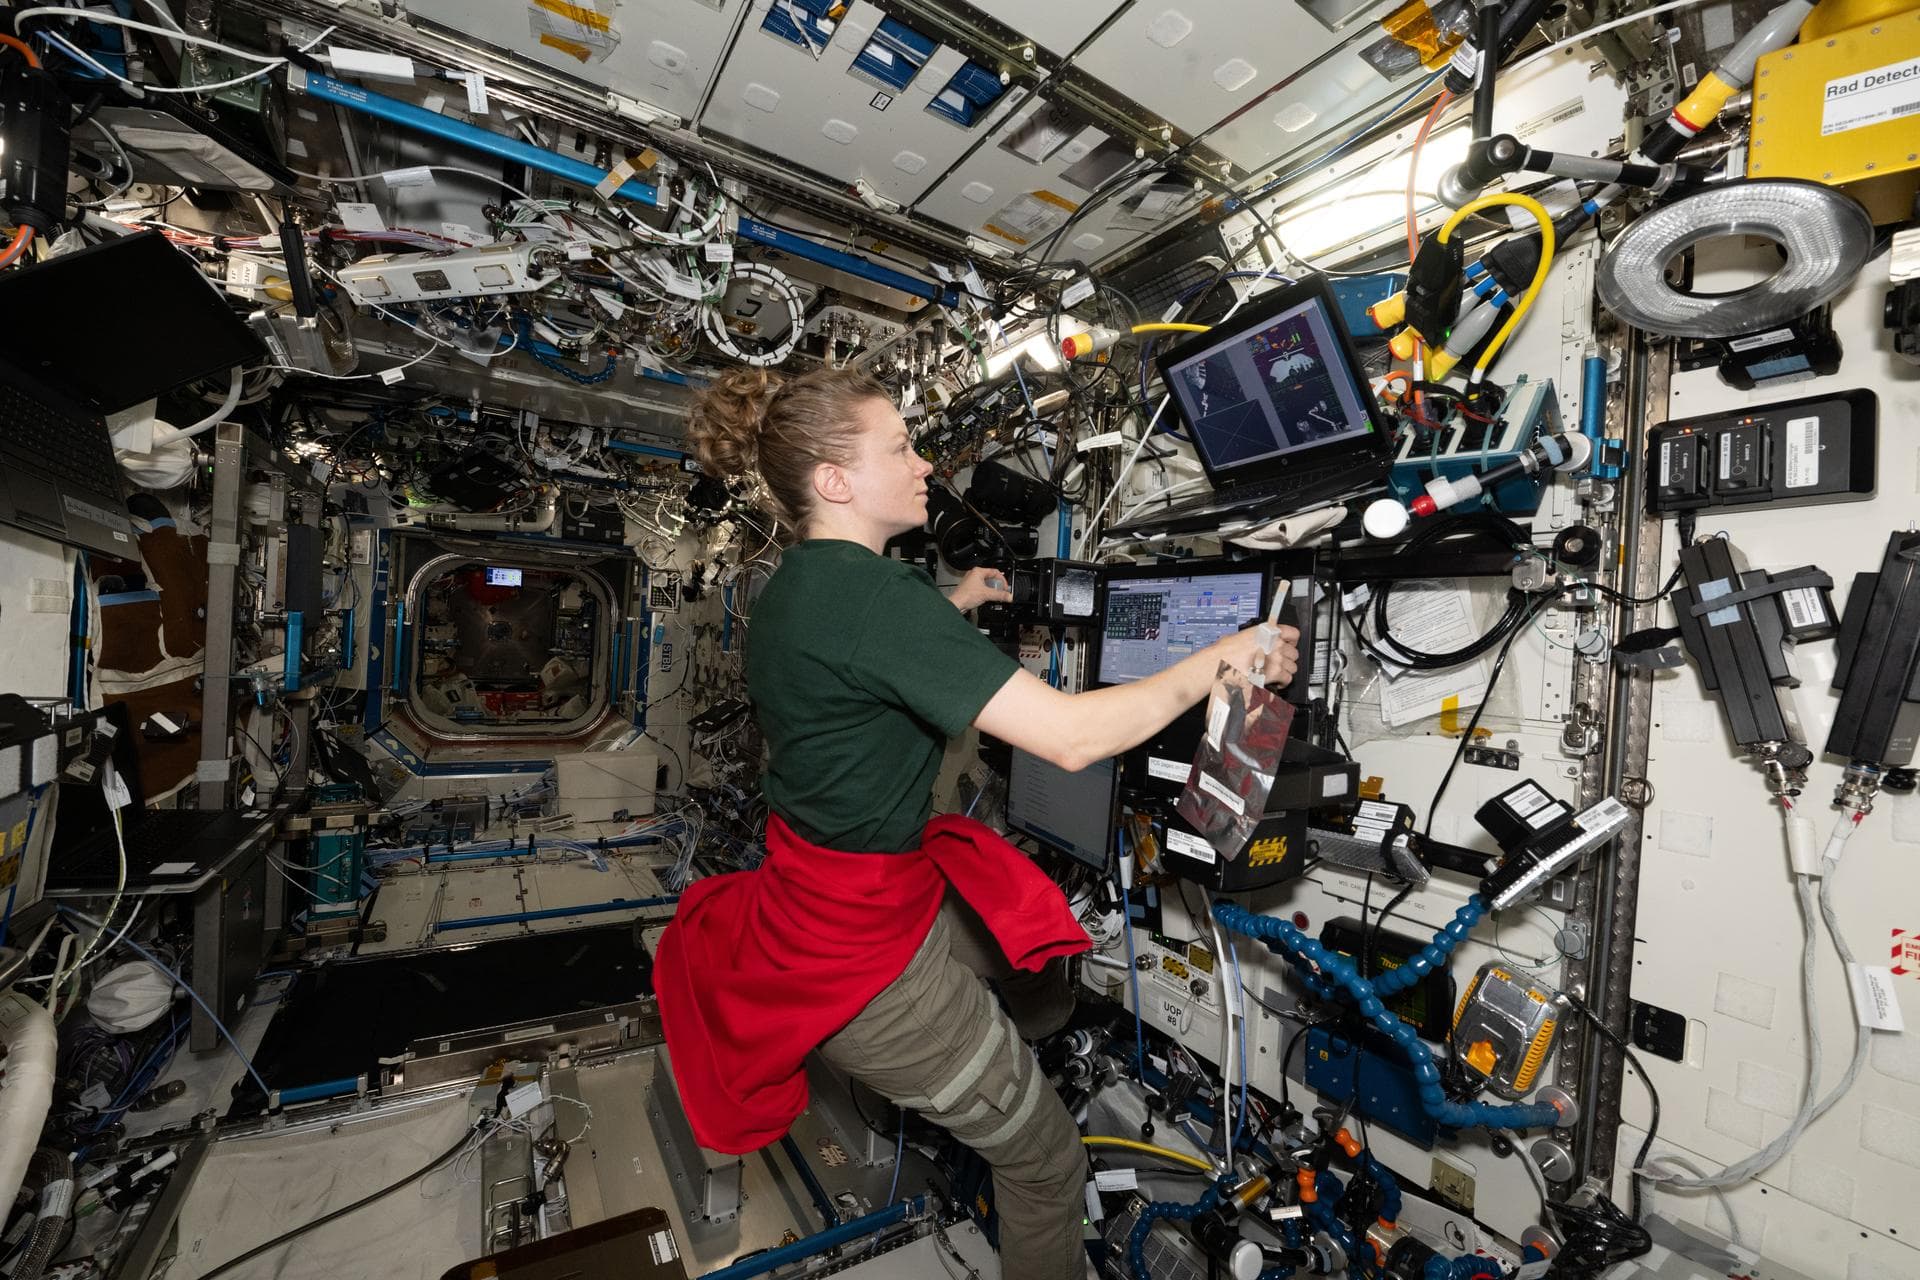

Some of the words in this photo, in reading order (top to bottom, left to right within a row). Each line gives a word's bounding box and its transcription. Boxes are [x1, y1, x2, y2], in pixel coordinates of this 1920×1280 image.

[1826, 80, 1859, 98] Rad
[1864, 65, 1920, 88] Detect
[1164, 1001, 1182, 1017] UOP
[1167, 1015, 1177, 1027] #8
